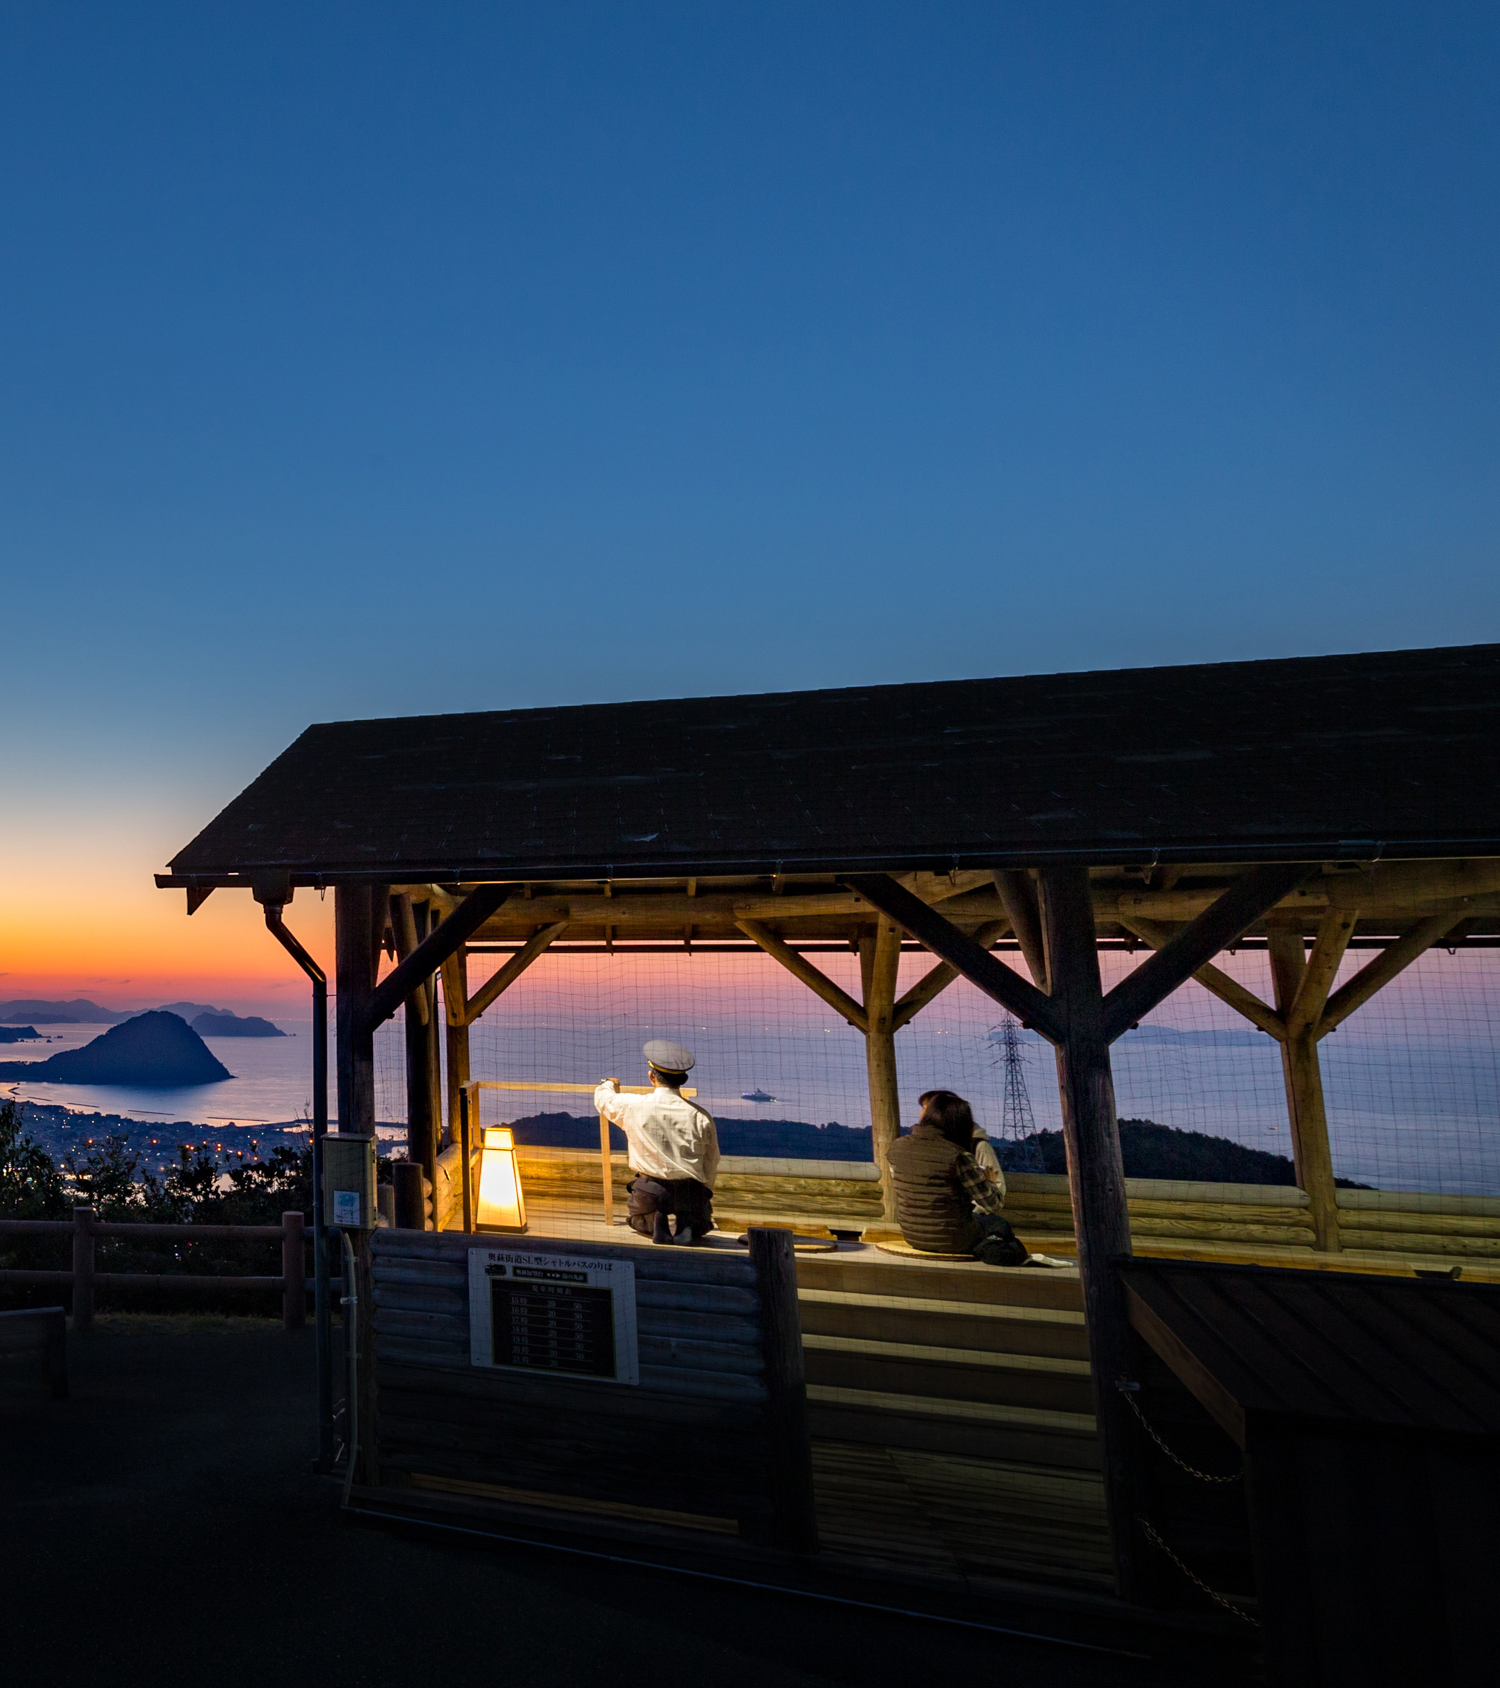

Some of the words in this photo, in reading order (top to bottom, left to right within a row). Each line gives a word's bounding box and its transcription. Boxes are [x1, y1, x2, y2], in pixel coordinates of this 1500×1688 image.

[487, 1252, 614, 1272] 奥萩街道SL型シャトルバスのりば
